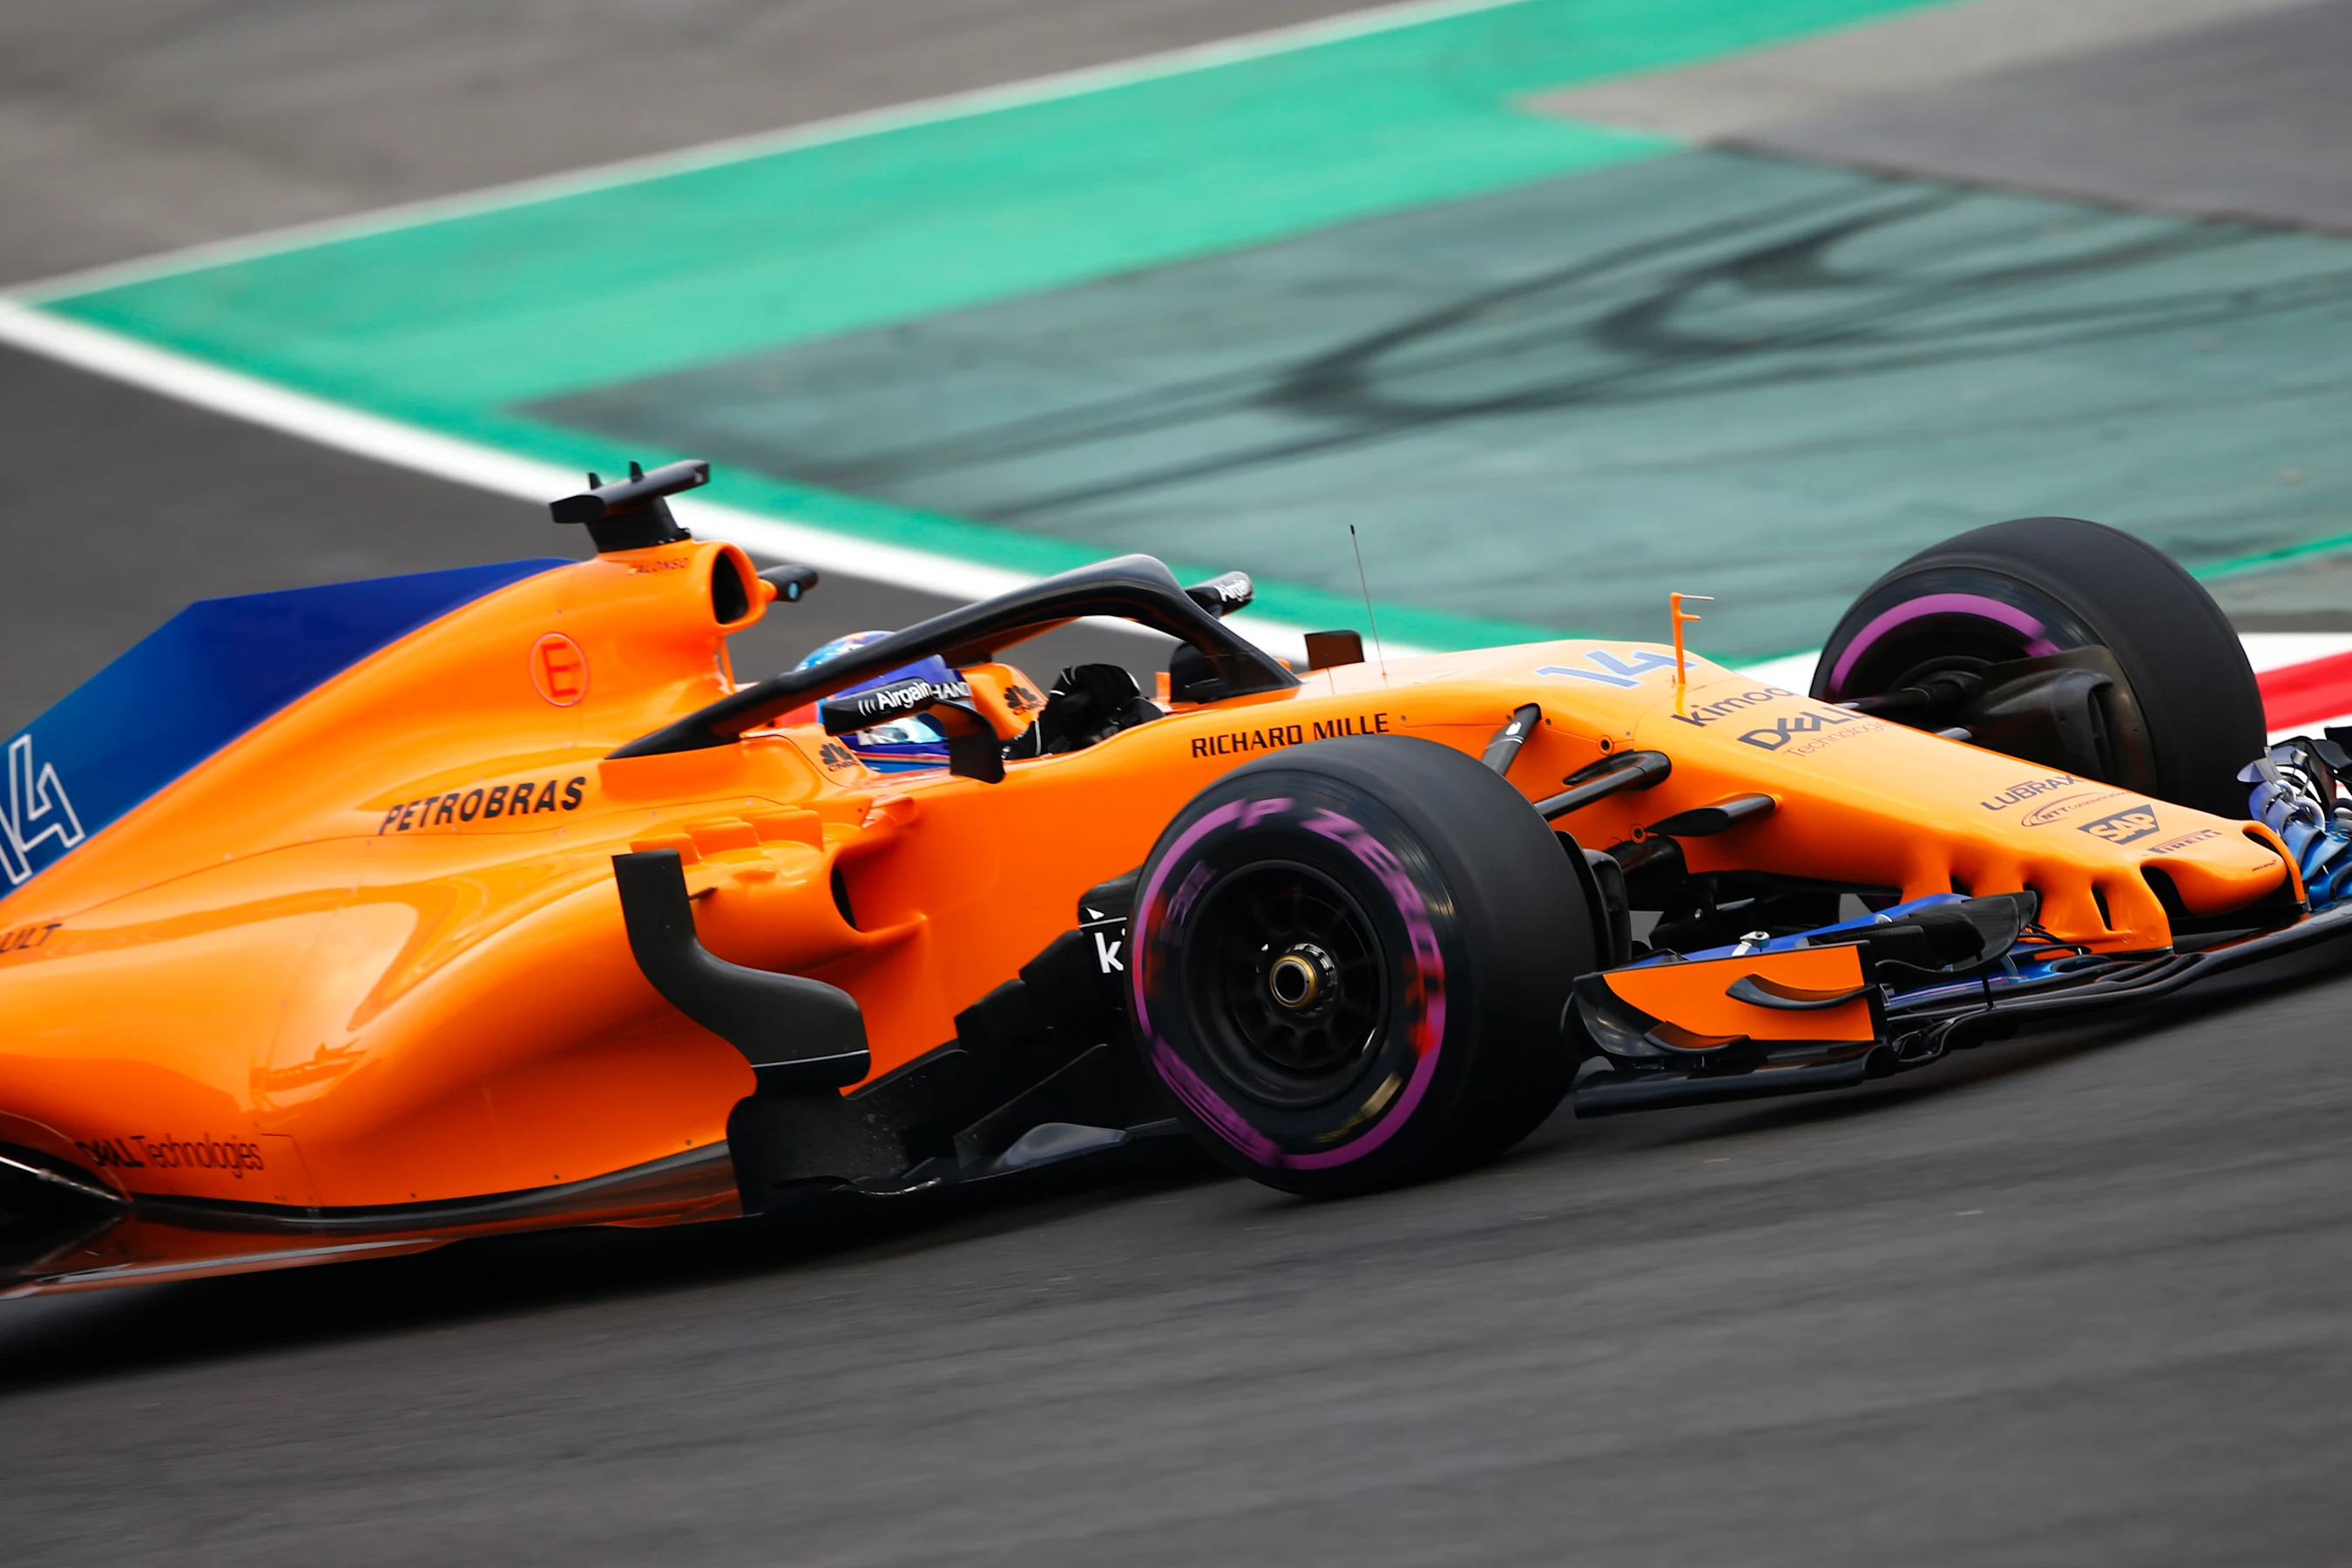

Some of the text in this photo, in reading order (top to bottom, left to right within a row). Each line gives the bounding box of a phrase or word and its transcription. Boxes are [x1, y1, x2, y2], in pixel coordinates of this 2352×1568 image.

[540, 641, 580, 697] E
[1532, 649, 1700, 690] 14
[875, 681, 933, 710] Airgain
[1191, 713, 1390, 758] RICHARD MILLE
[1737, 706, 1873, 752] DELL
[377, 776, 586, 835] PETROBRAS
[1980, 774, 2085, 811] LUBRAX
[2041, 807, 2070, 820] NTT
[2088, 812, 2156, 842] SAP
[2146, 829, 2223, 855] PIRELLI
[130, 1132, 265, 1179] Technologies
